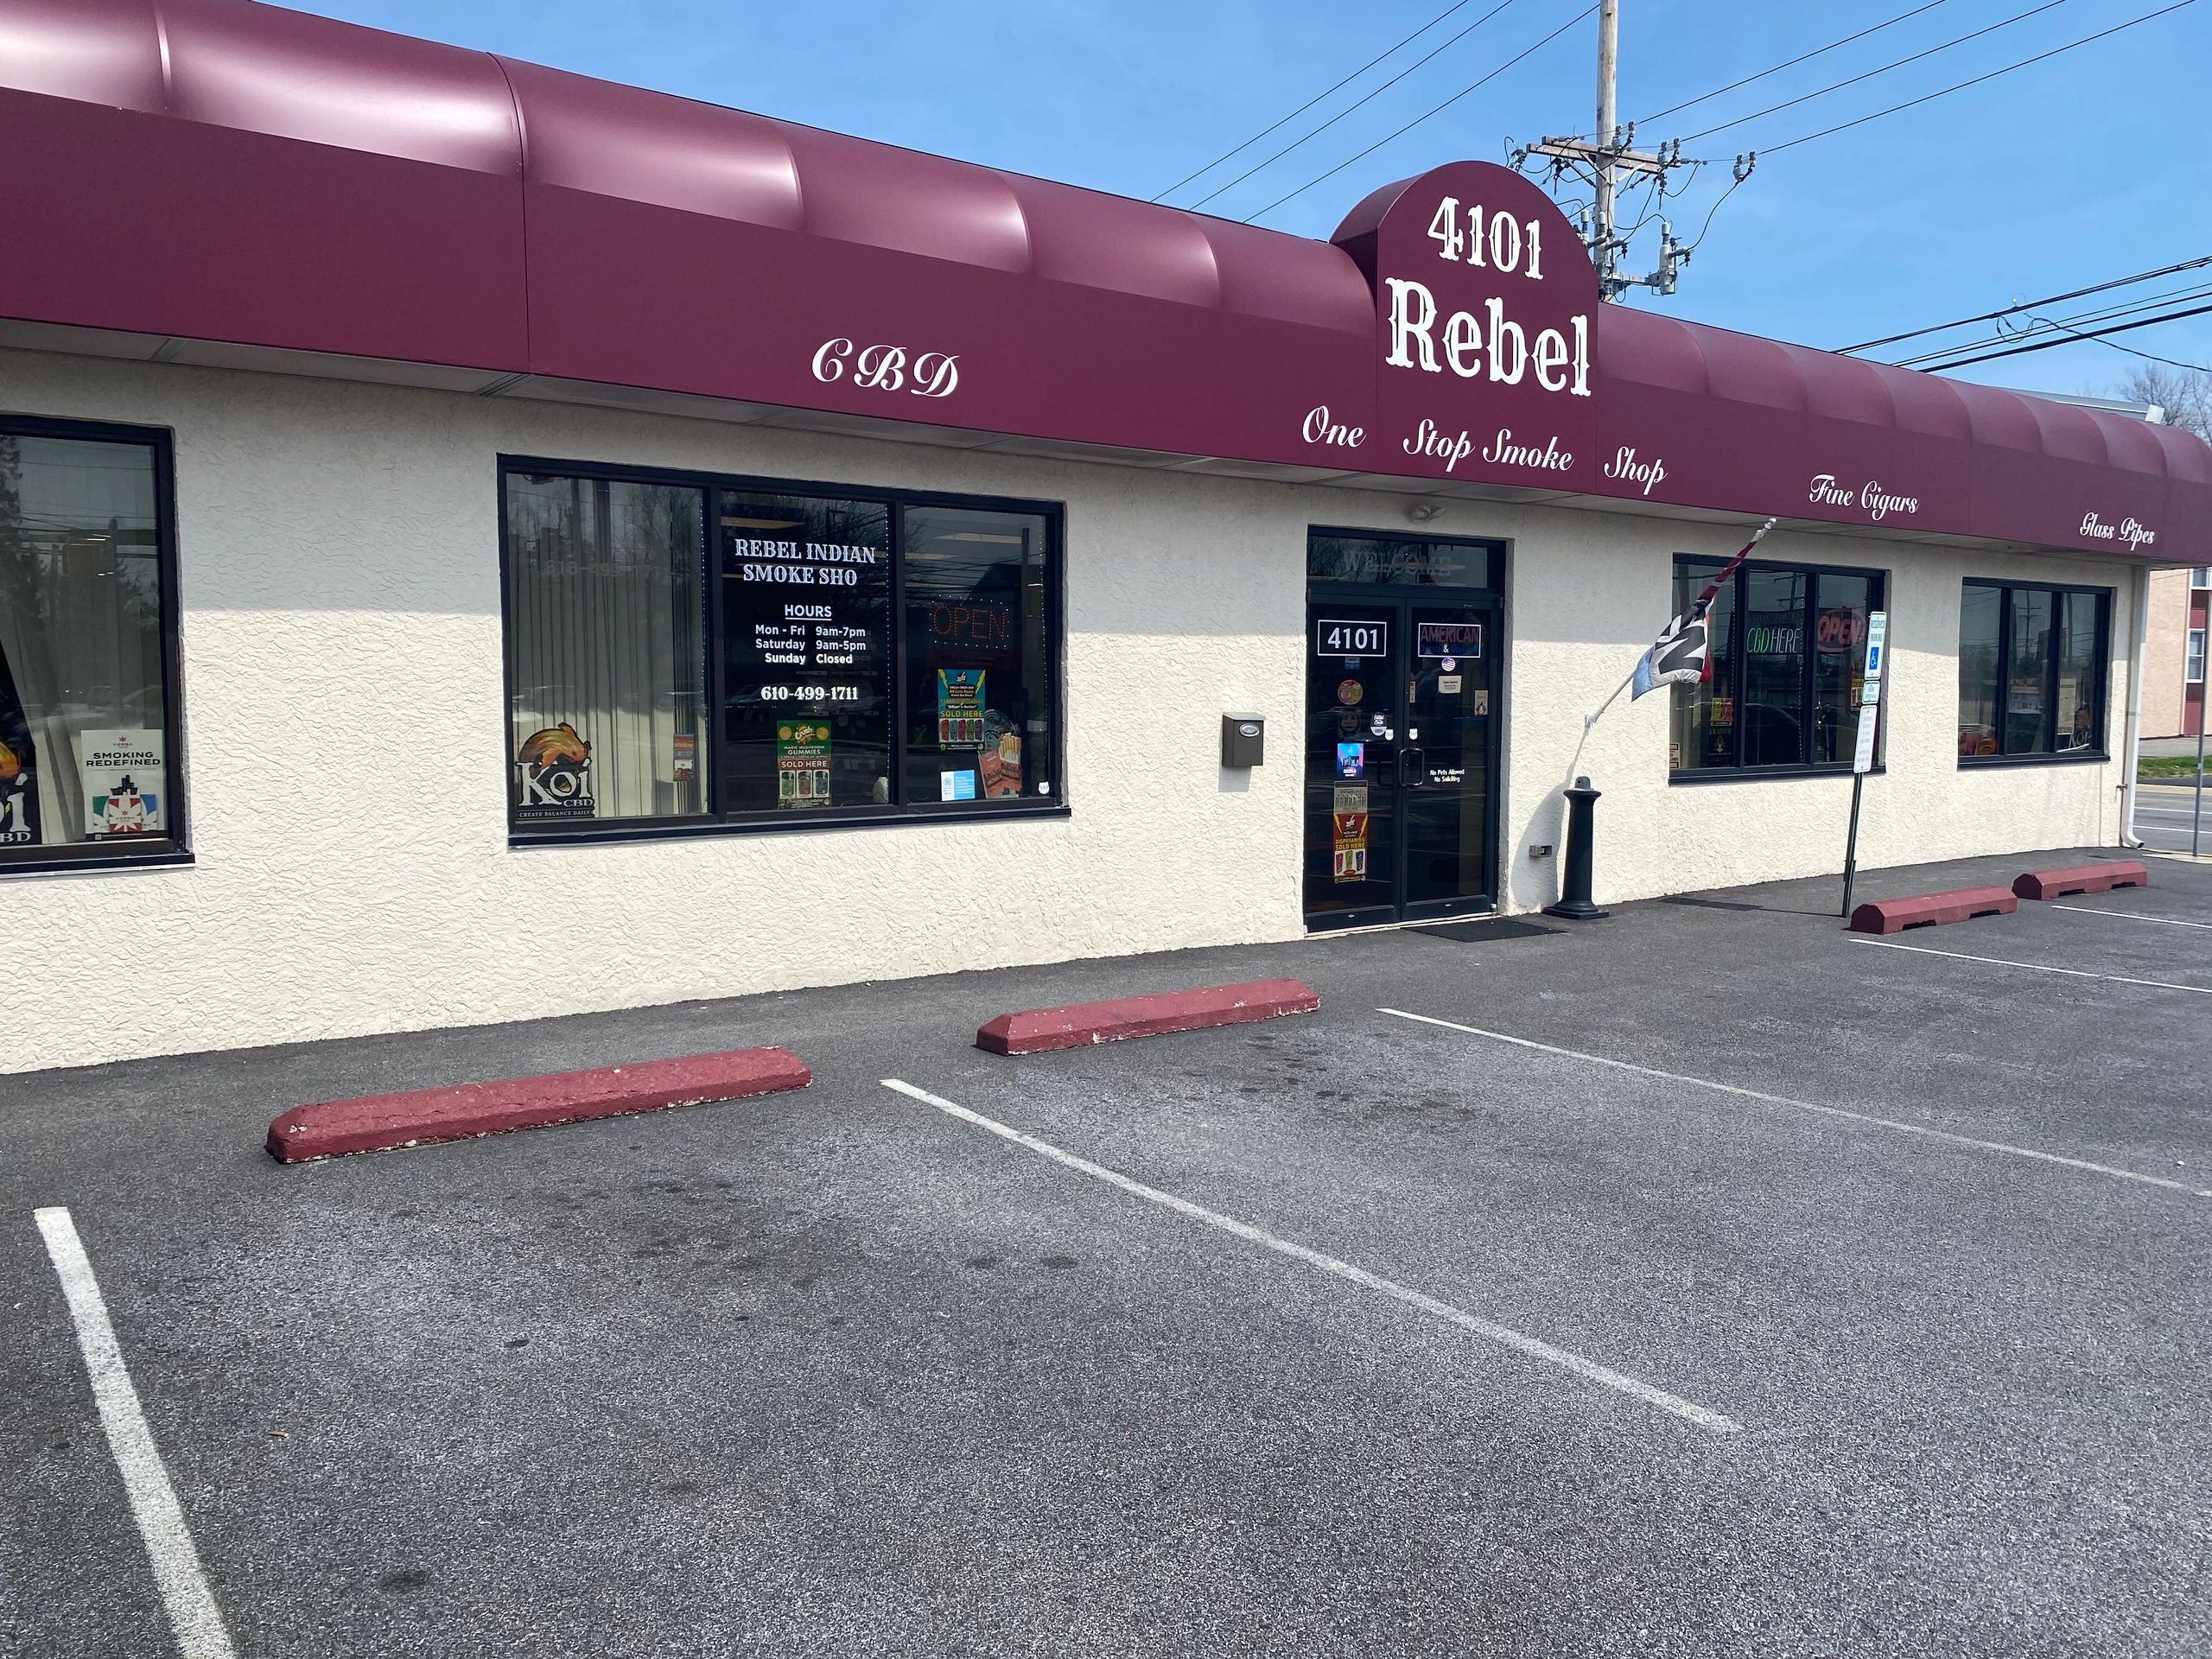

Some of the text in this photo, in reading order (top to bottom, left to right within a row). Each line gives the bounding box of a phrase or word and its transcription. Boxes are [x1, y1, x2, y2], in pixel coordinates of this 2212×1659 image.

[1427, 195, 1544, 280] 4101
[1384, 276, 1592, 397] Rebel
[811, 338, 960, 397] CBD
[1301, 404, 1668, 495] One Stop Smoke Shop
[1808, 474, 1920, 521] Fine Cigars
[2079, 511, 2156, 551] Glass Pipes
[734, 538, 876, 563] REBEL INDIAN
[743, 564, 858, 586] SMOKE SHO
[785, 604, 832, 618] HOURS
[755, 624, 779, 635] Mon
[791, 625, 805, 635] Fri
[815, 626, 866, 639] 9am-7pm
[933, 605, 1006, 640] OPEN
[1818, 614, 1863, 645] OPEN
[755, 639, 866, 652] Saturday 9am-5pm
[1327, 626, 1377, 650] 4101
[1421, 626, 1479, 643] AMERICAN
[1746, 627, 1801, 653] CBD HERE
[765, 652, 806, 665] Sunday
[816, 654, 853, 664] Closed
[1443, 644, 1449, 653] &
[760, 686, 859, 701] 610-499-1711
[86, 759, 161, 767] REDEFINED
[93, 751, 154, 760] SMOKING
[563, 798, 594, 808] CBD
[0, 832, 31, 842] BD
